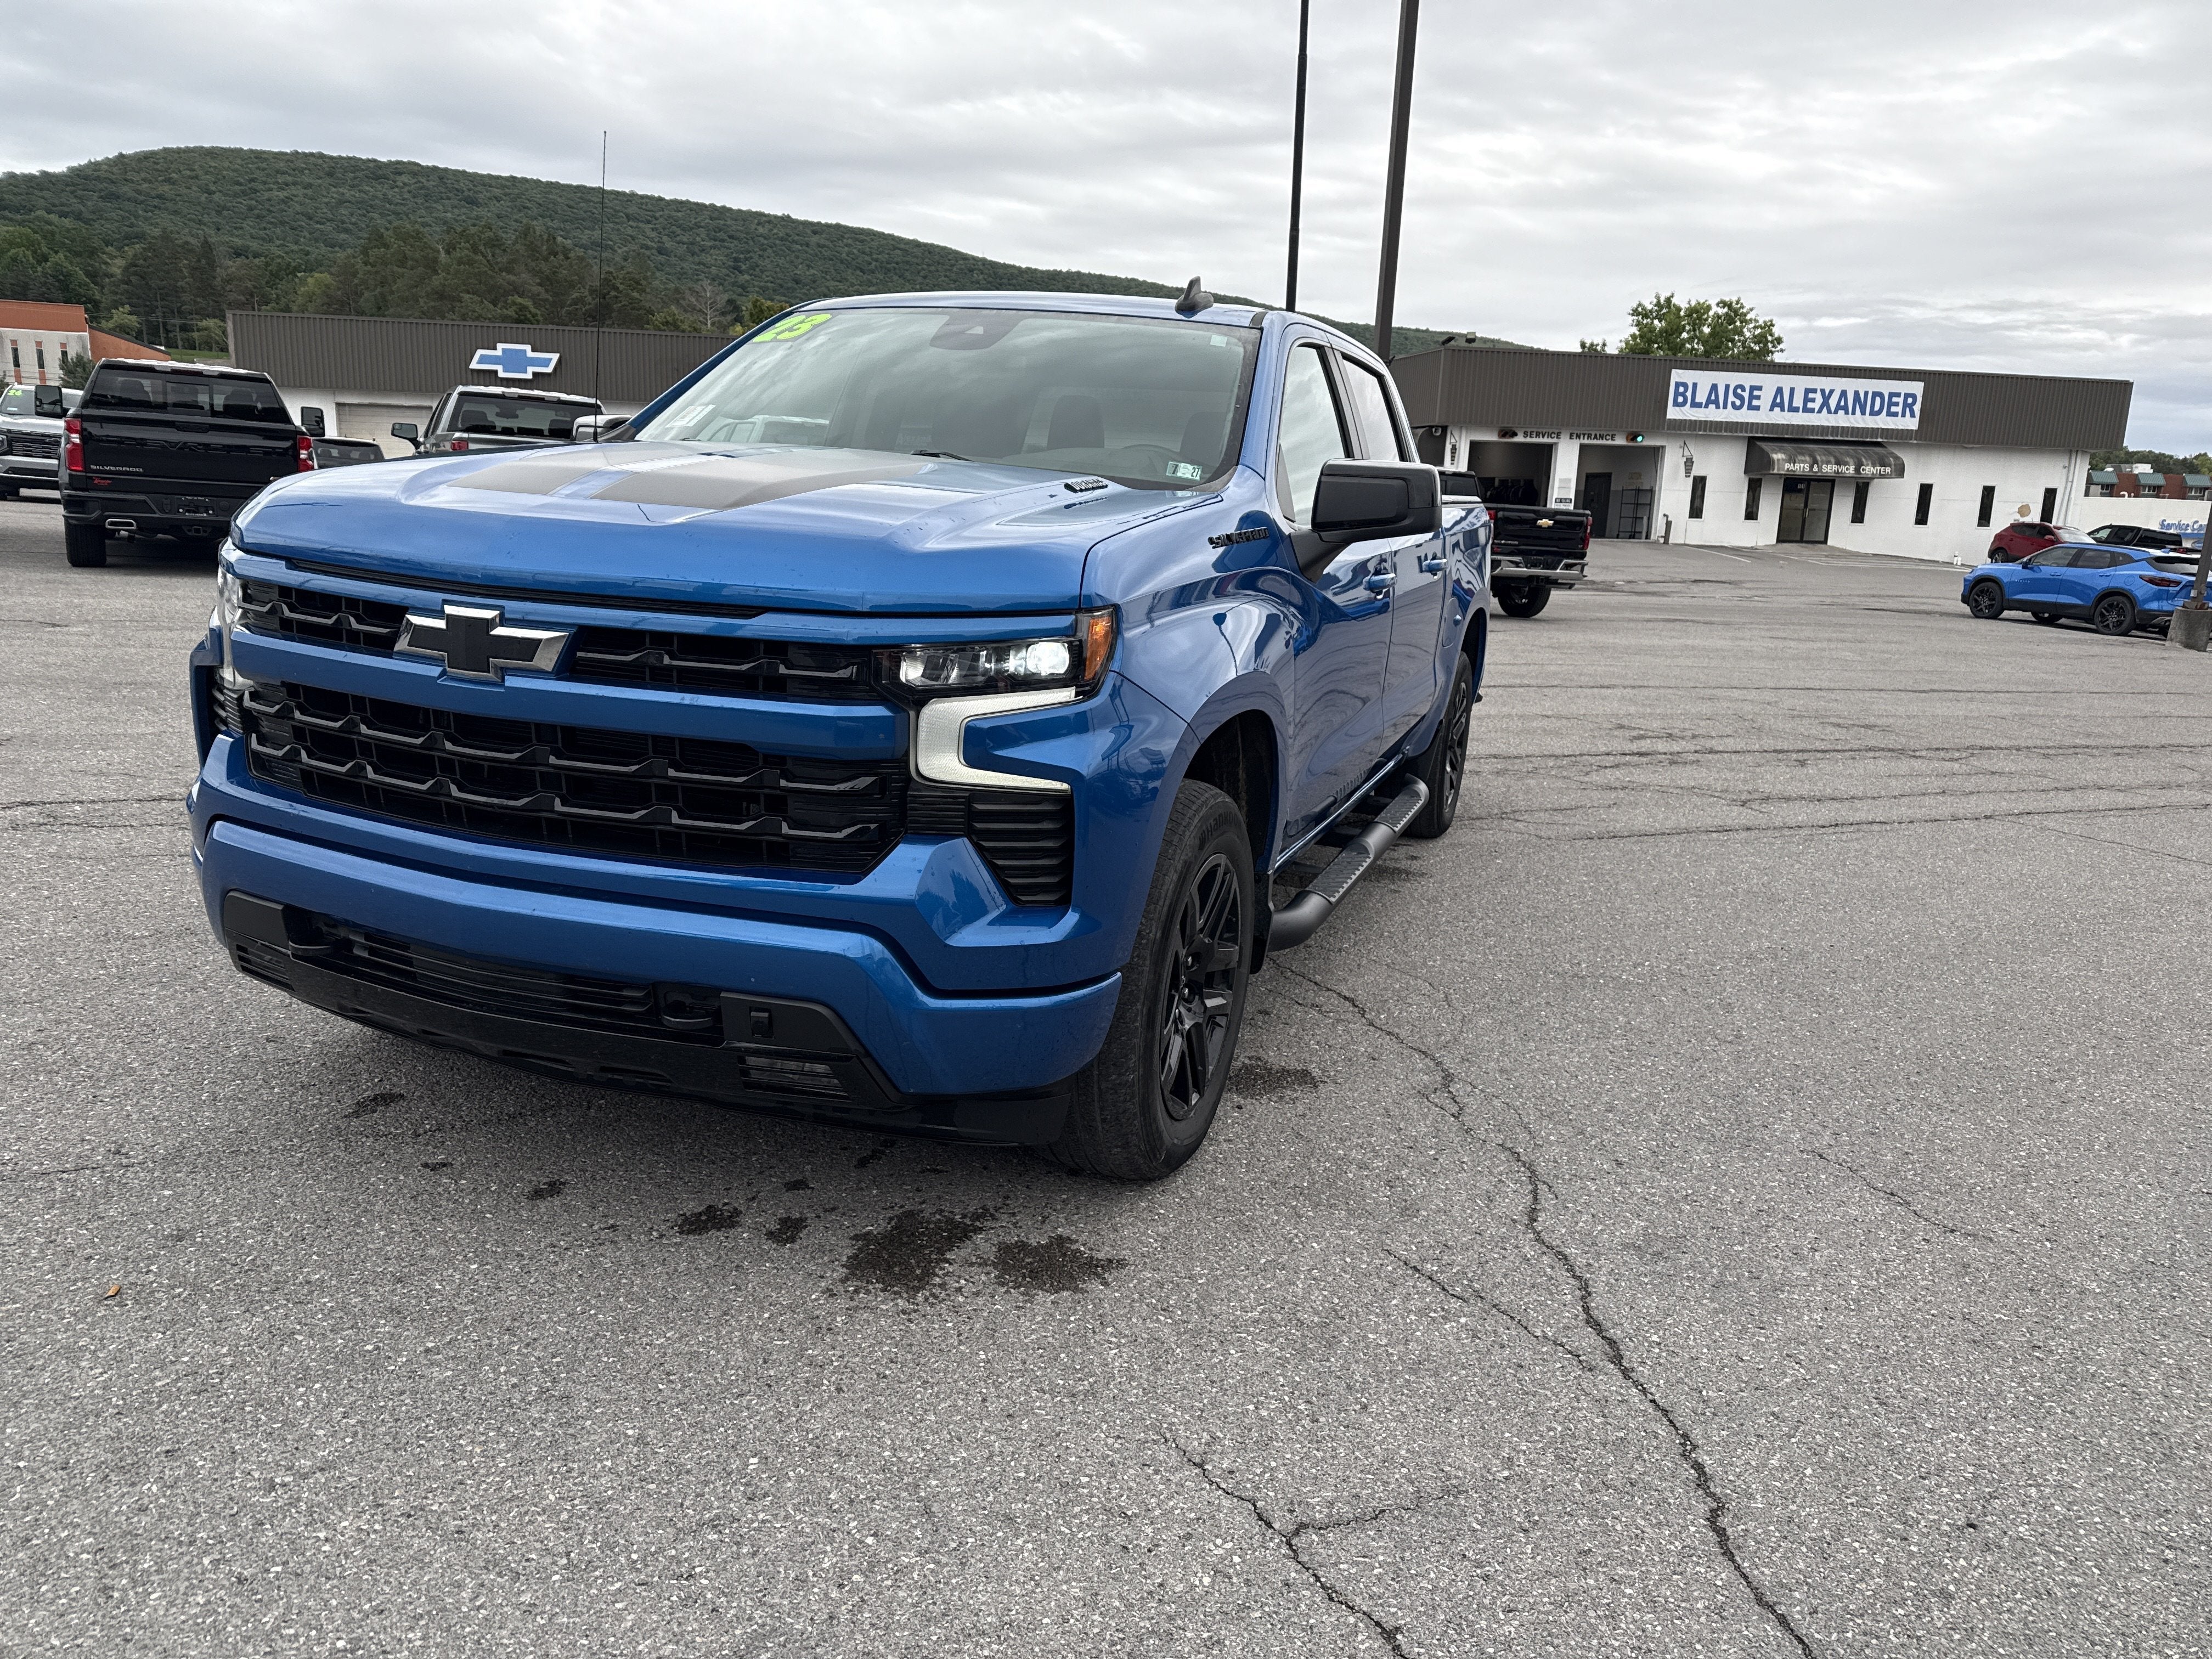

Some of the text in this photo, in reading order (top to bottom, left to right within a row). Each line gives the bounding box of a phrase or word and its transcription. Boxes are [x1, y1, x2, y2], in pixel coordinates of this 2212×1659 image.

[752, 314, 832, 343] 23
[1672, 381, 1918, 418] BLAISE ALEXANDER
[1523, 431, 1616, 441] SERVICE ENTRANCE
[1171, 464, 1200, 478] 7 27
[1785, 463, 1810, 472] PARTS
[1822, 464, 1855, 473] SERVICE
[1860, 466, 1892, 475] CENTER
[2159, 518, 2190, 531] Service
[1207, 526, 1269, 549] SILVERADO
